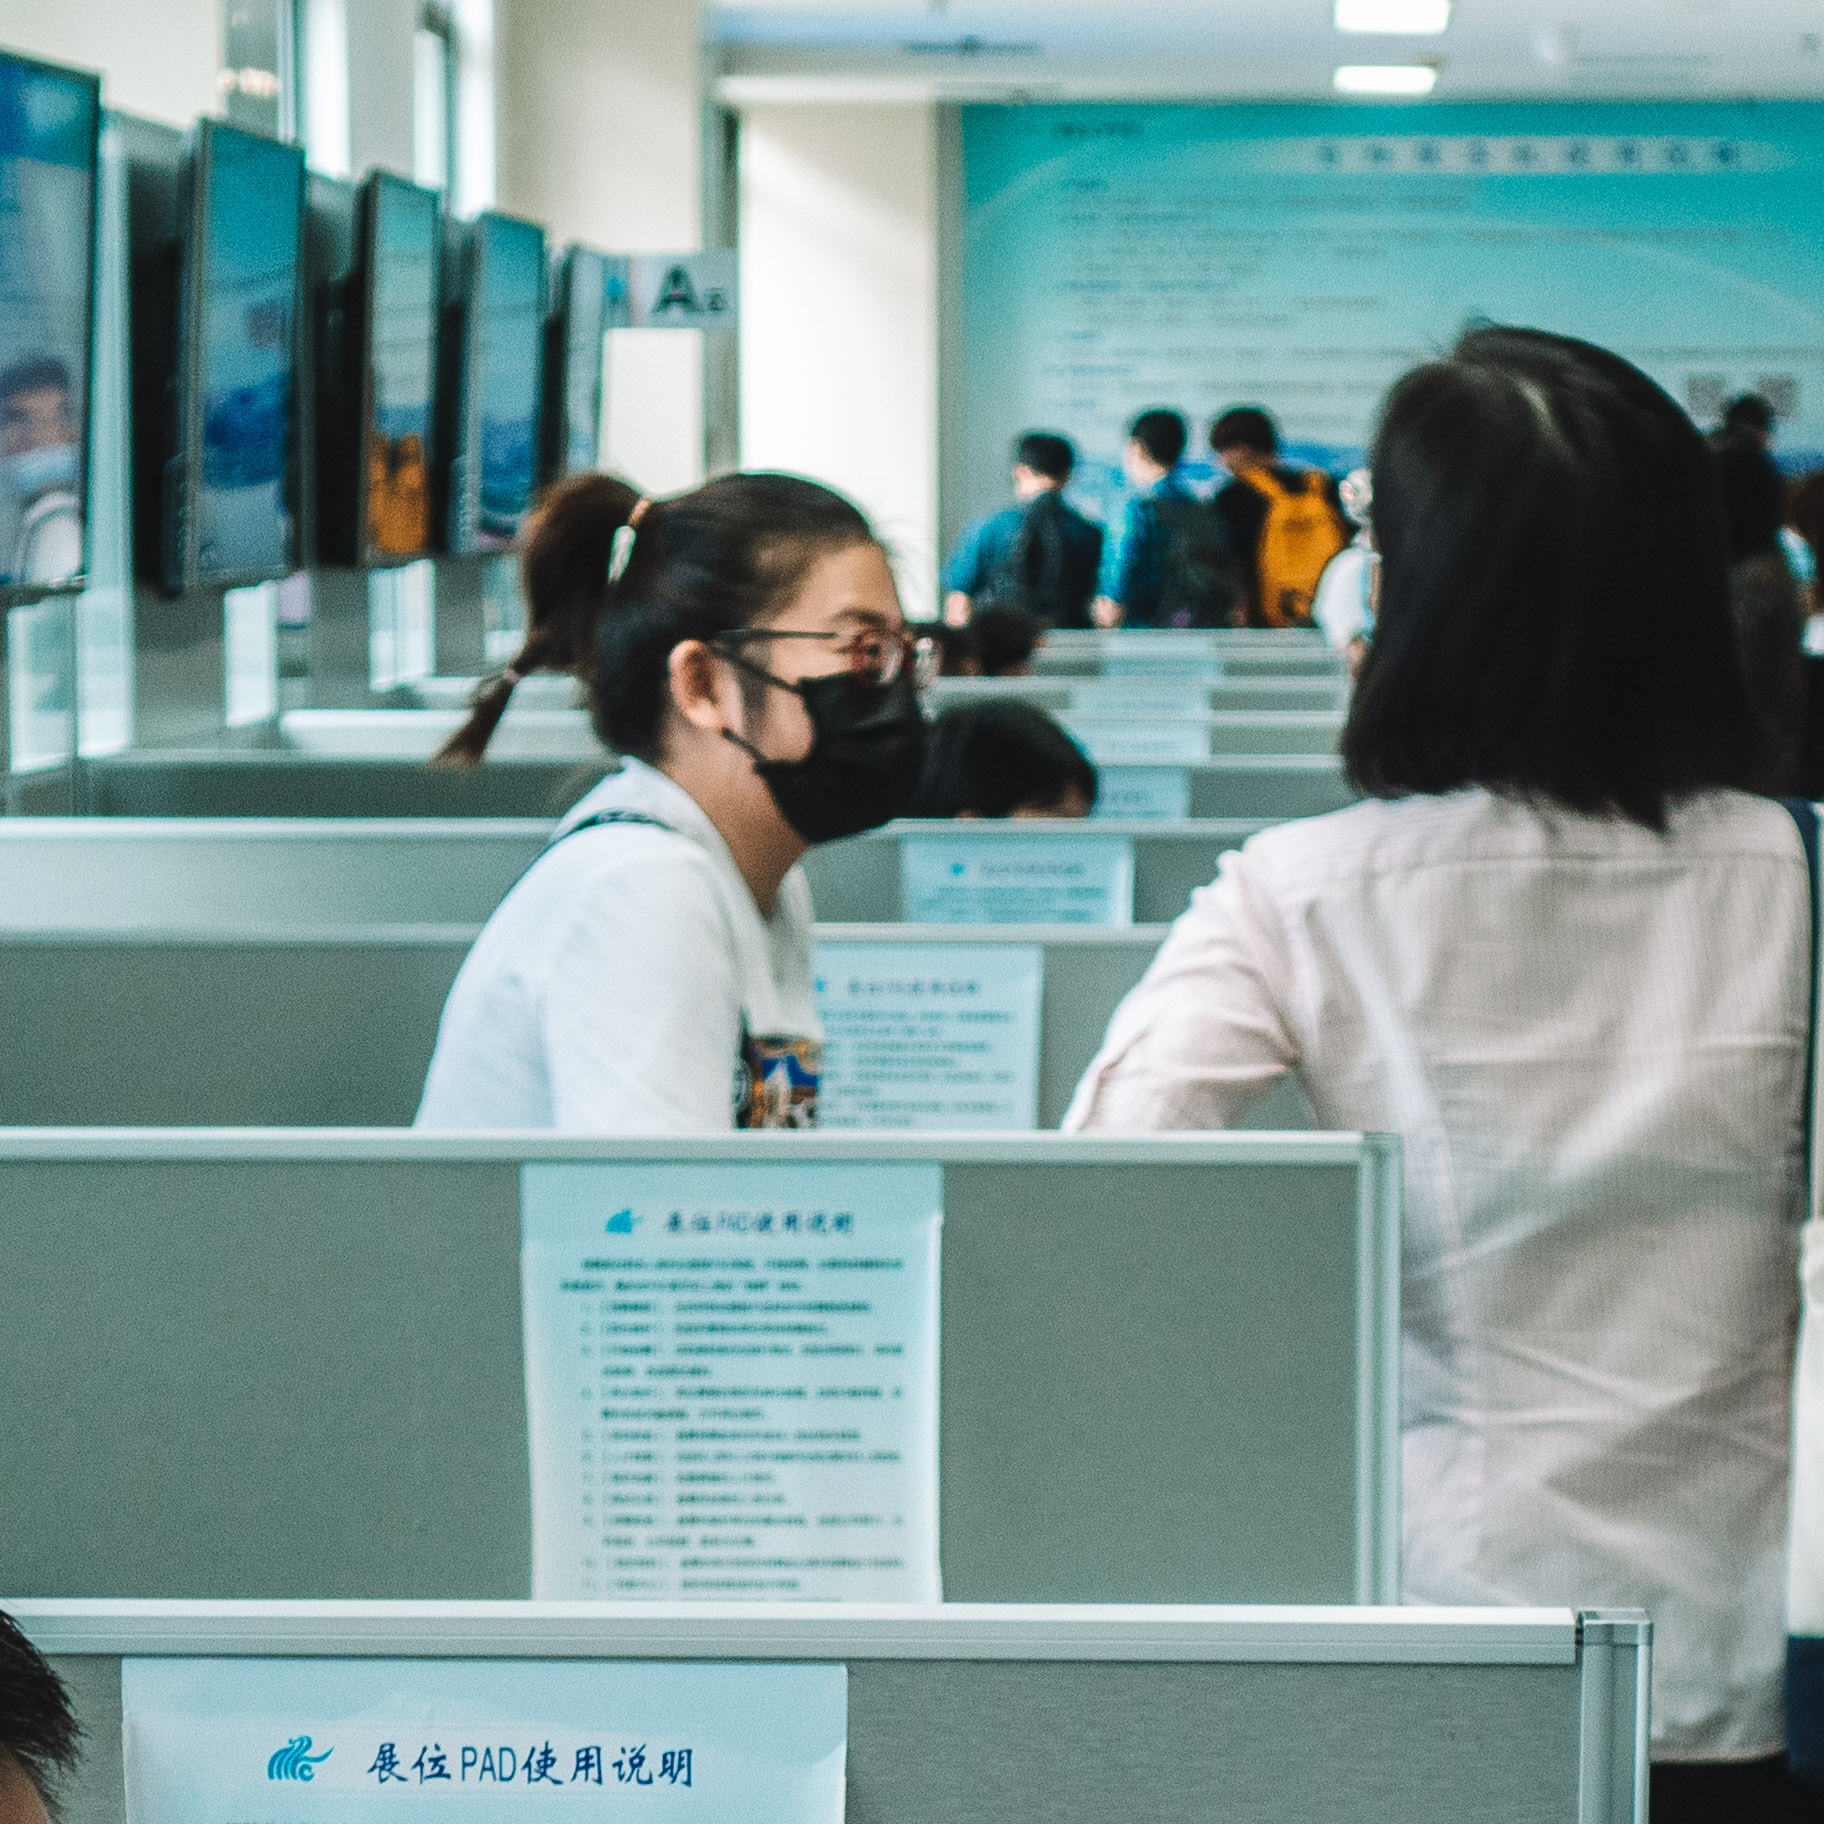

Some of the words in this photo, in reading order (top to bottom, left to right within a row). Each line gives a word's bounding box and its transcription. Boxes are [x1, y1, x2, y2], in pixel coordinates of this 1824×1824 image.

[366, 1740, 694, 1789] 展位PAD使用说明
